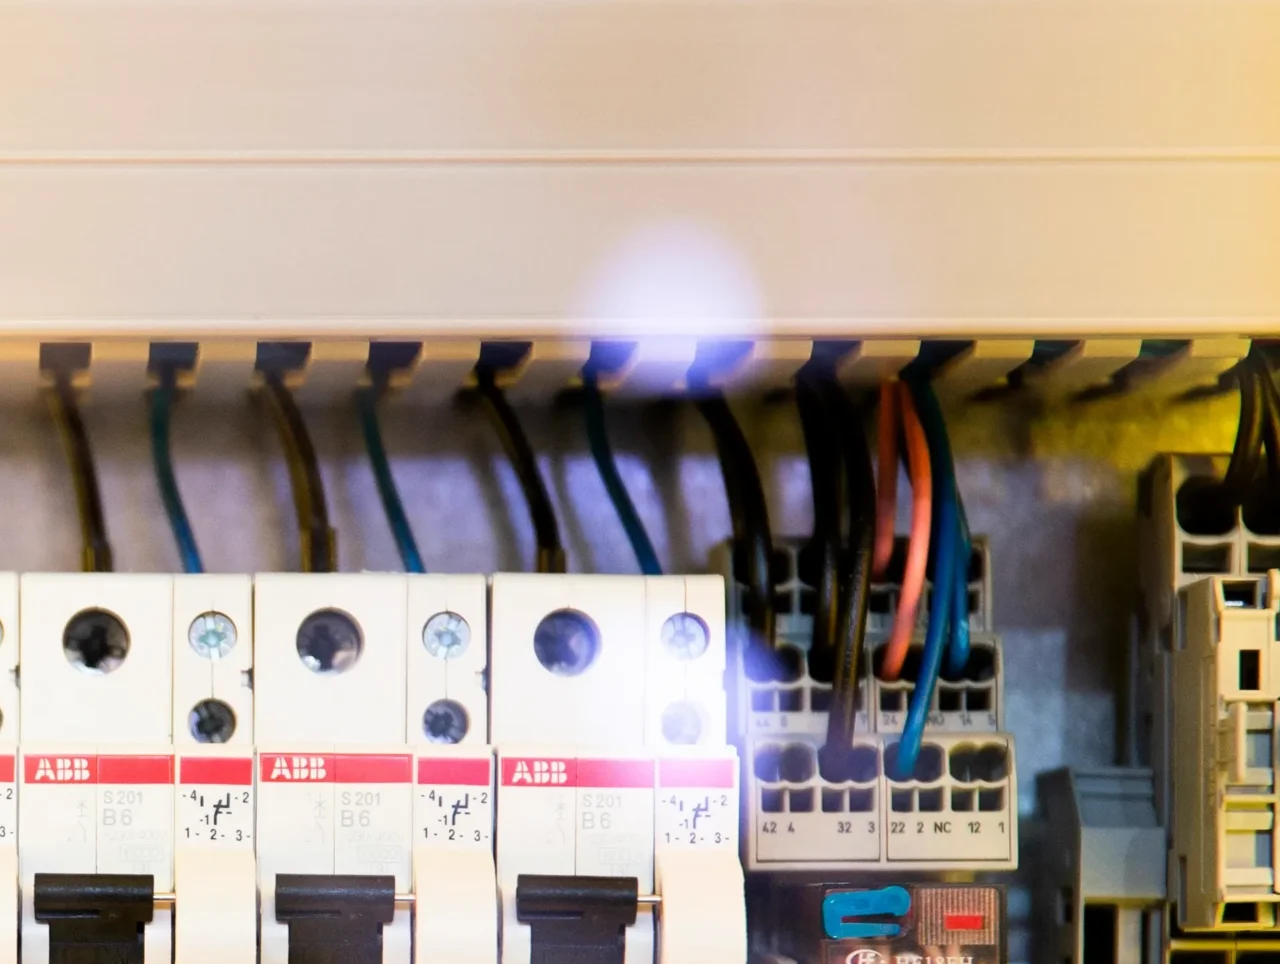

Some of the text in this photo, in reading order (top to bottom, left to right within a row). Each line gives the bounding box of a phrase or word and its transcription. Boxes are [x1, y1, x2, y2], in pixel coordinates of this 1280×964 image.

[34, 758, 90, 781] ABB
[271, 757, 327, 780] ABB
[511, 760, 568, 784] ABB
[762, 821, 795, 834] 42 4
[837, 821, 876, 834] 32 3
[891, 821, 1005, 834] 22 2 NC 12 1
